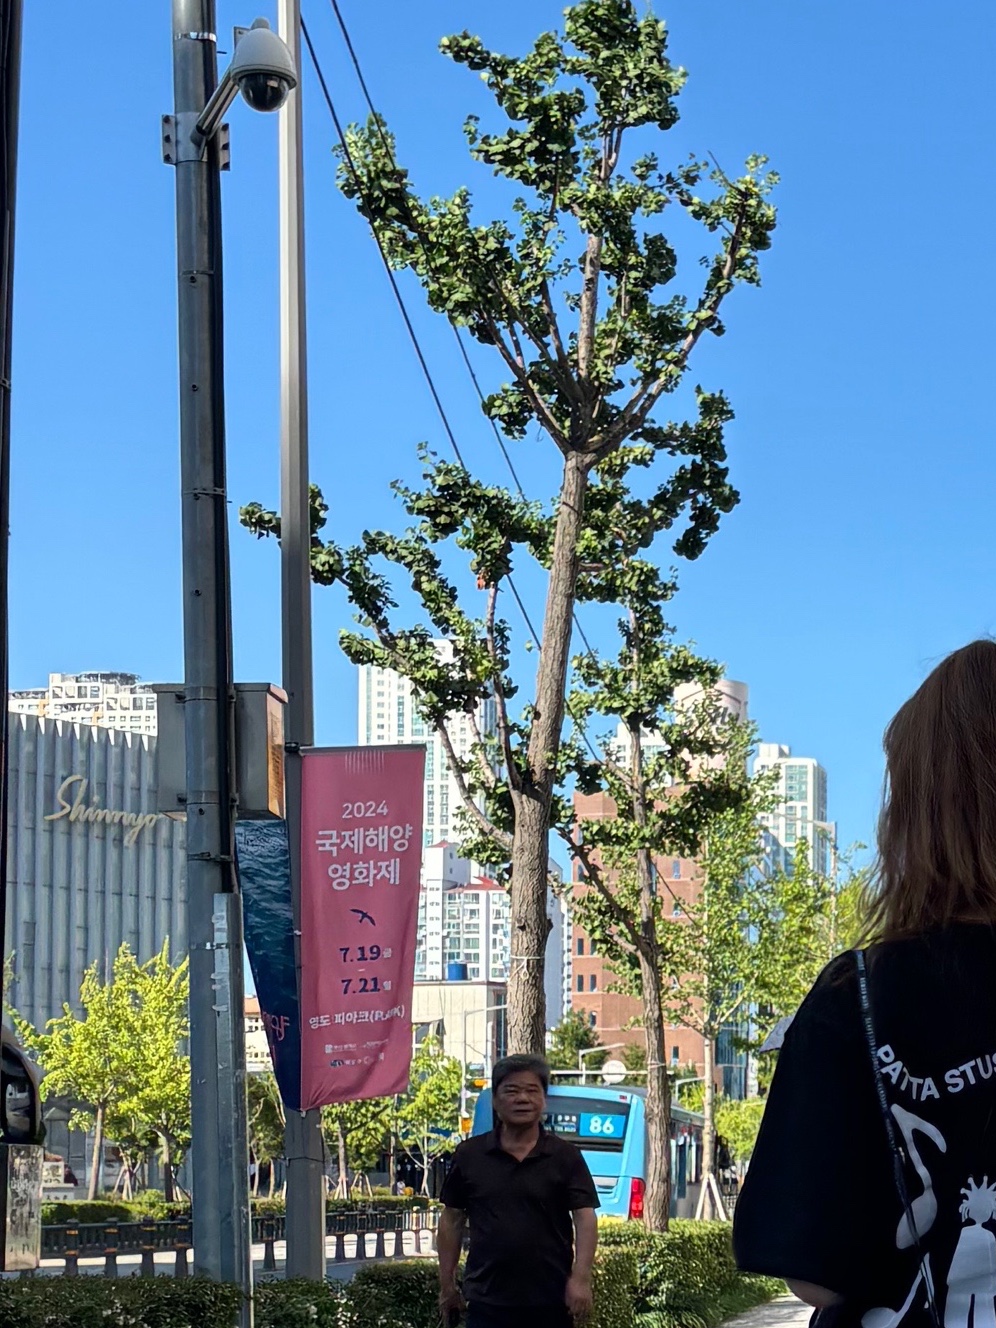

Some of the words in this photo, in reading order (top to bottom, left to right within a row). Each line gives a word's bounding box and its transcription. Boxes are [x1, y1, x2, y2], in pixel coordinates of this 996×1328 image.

[342, 800, 389, 819] 2024
[315, 823, 413, 857] 국제해양
[327, 858, 400, 890] 영화제
[339, 945, 381, 963] 7.19
[341, 977, 381, 995] 7.21
[309, 1015, 331, 1029] 영도
[877, 1044, 940, 1101] PATTA
[589, 1115, 615, 1134] 86
